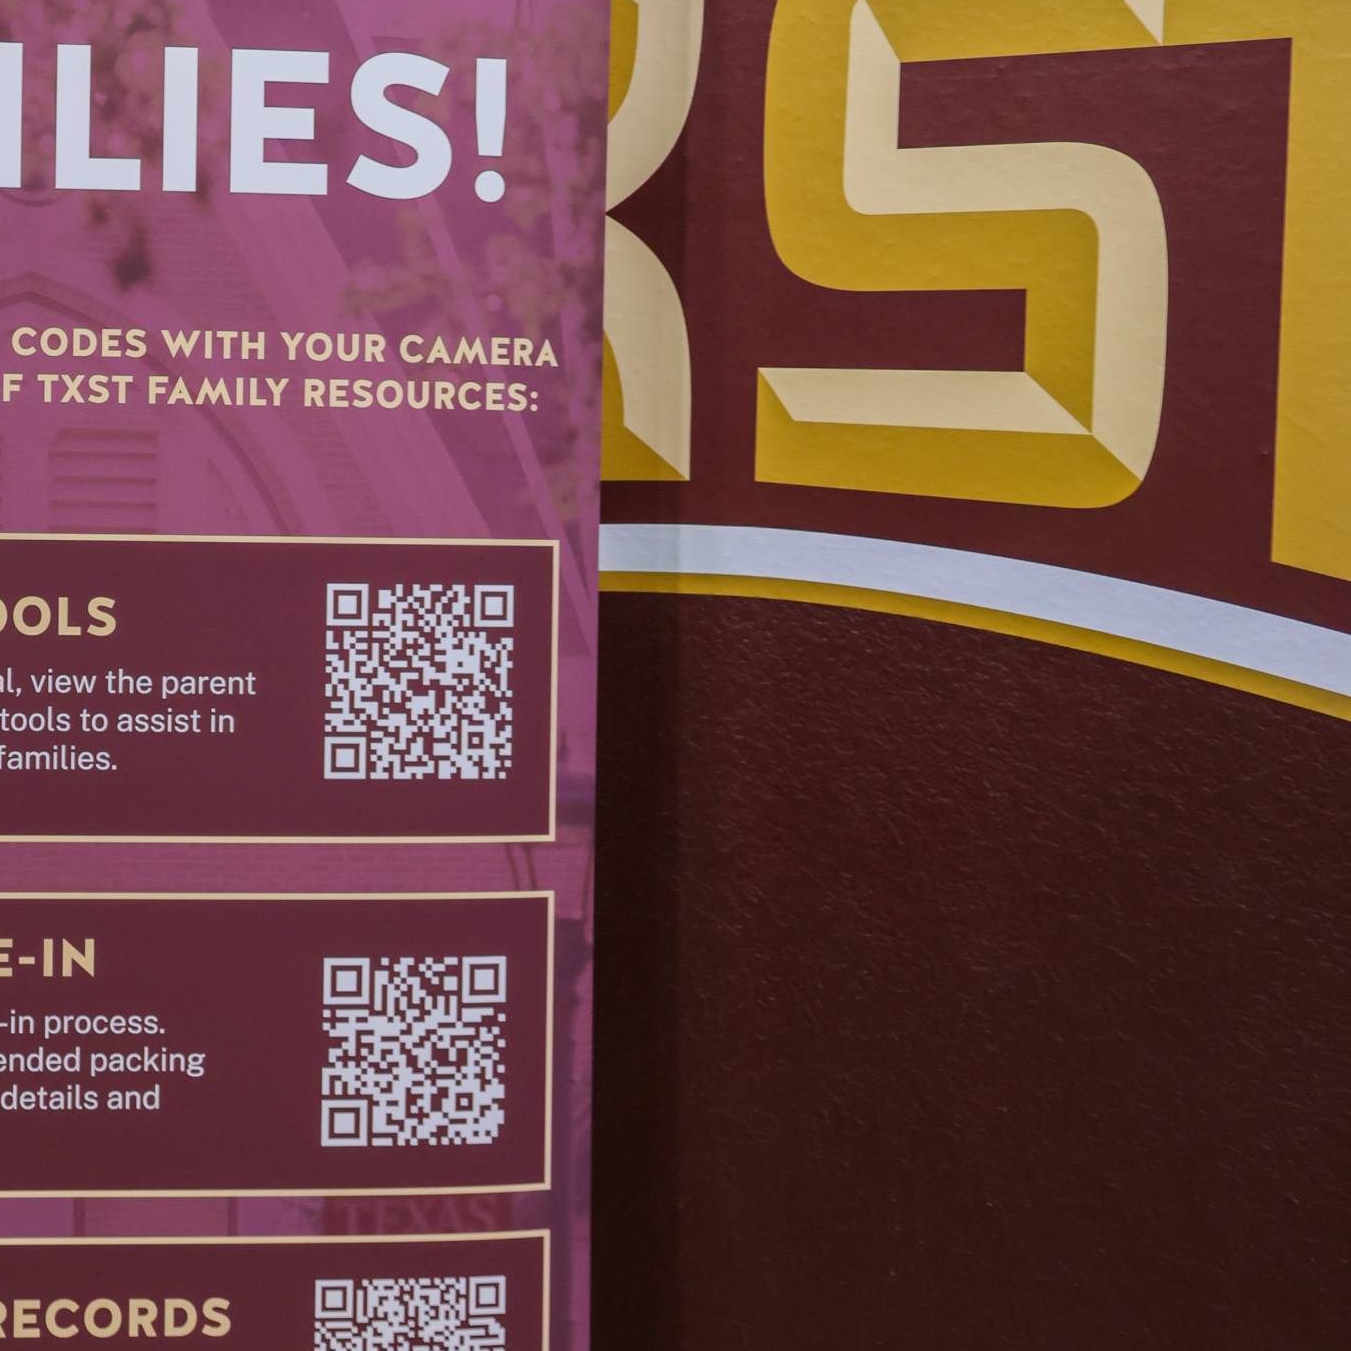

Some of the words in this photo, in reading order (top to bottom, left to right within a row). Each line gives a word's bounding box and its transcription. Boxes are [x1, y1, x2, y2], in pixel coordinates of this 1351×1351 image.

[11, 325, 147, 359] CODES
[160, 328, 266, 361] WITH
[280, 330, 387, 364] YOUR
[399, 334, 559, 368] CAMERA
[36, 373, 134, 405] TXST
[148, 374, 290, 407] FAMILY
[303, 377, 539, 413] RESOURCES:
[30, 667, 97, 695] view
[104, 667, 153, 695] the
[161, 670, 257, 700] parent
[79, 708, 109, 733] to
[116, 706, 202, 734] assist
[210, 706, 235, 734] in
[44, 1014, 166, 1040] process.
[90, 1045, 206, 1078] packing
[0, 1083, 99, 1112] details
[106, 1083, 160, 1111] and
